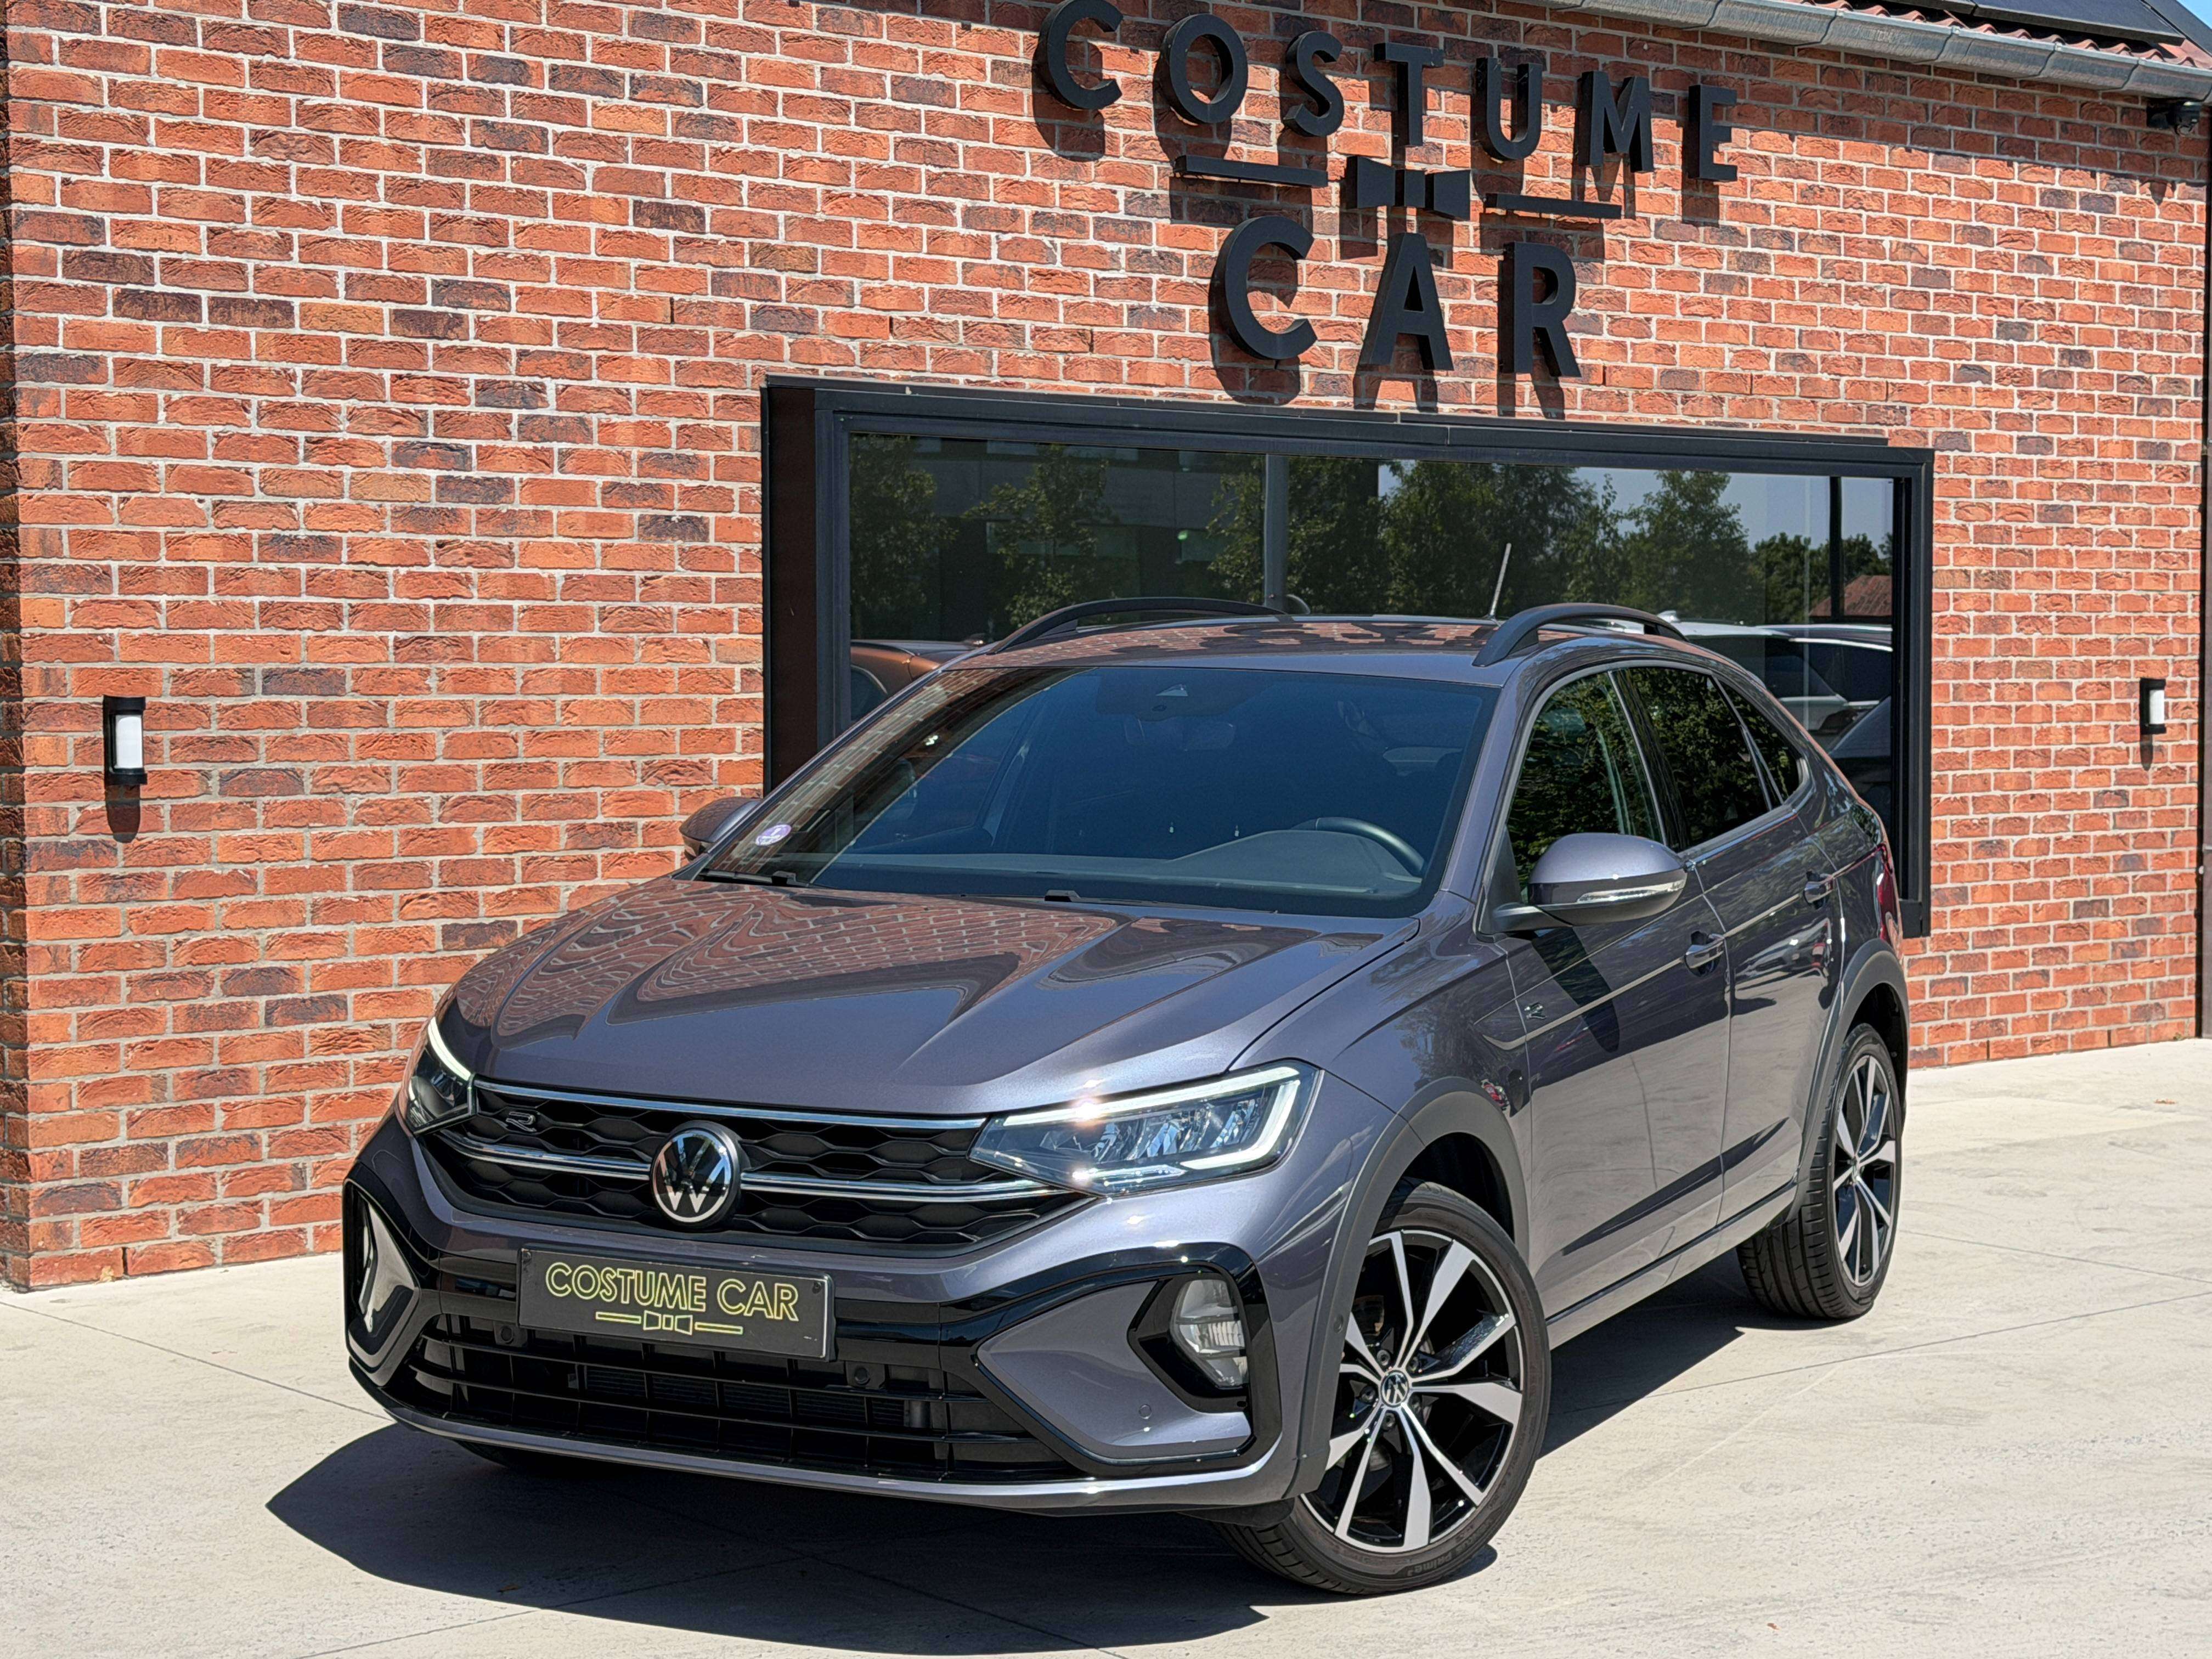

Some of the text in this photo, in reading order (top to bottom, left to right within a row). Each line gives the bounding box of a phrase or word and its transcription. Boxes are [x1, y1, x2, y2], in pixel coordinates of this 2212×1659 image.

[1037, 0, 1738, 182] COSTUME
[1214, 216, 1582, 378] CAR
[505, 1111, 537, 1132] R
[651, 1127, 733, 1223] VW
[545, 1262, 799, 1322] COSTUME CAR
